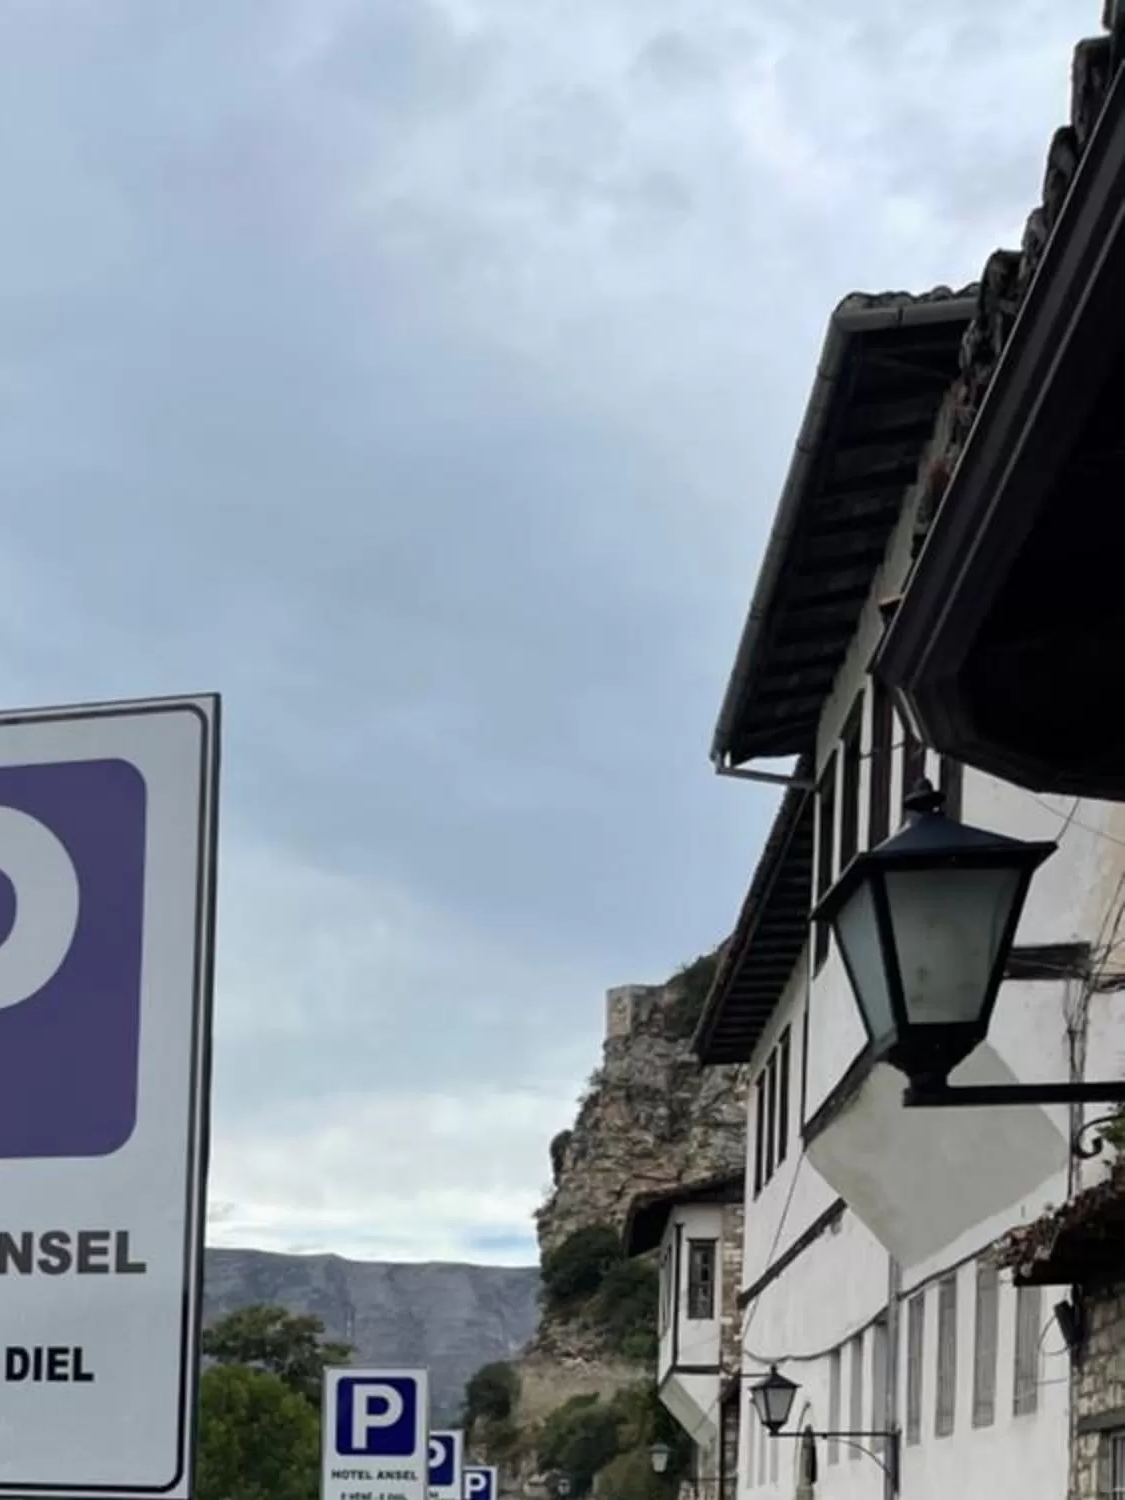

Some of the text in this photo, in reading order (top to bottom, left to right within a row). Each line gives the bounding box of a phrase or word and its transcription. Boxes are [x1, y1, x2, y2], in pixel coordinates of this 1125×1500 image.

[5, 1346, 94, 1382] DIEL
[352, 1384, 403, 1449] P
[331, 1469, 418, 1481] HOTEL ANSEL
[464, 1473, 487, 1500] P
